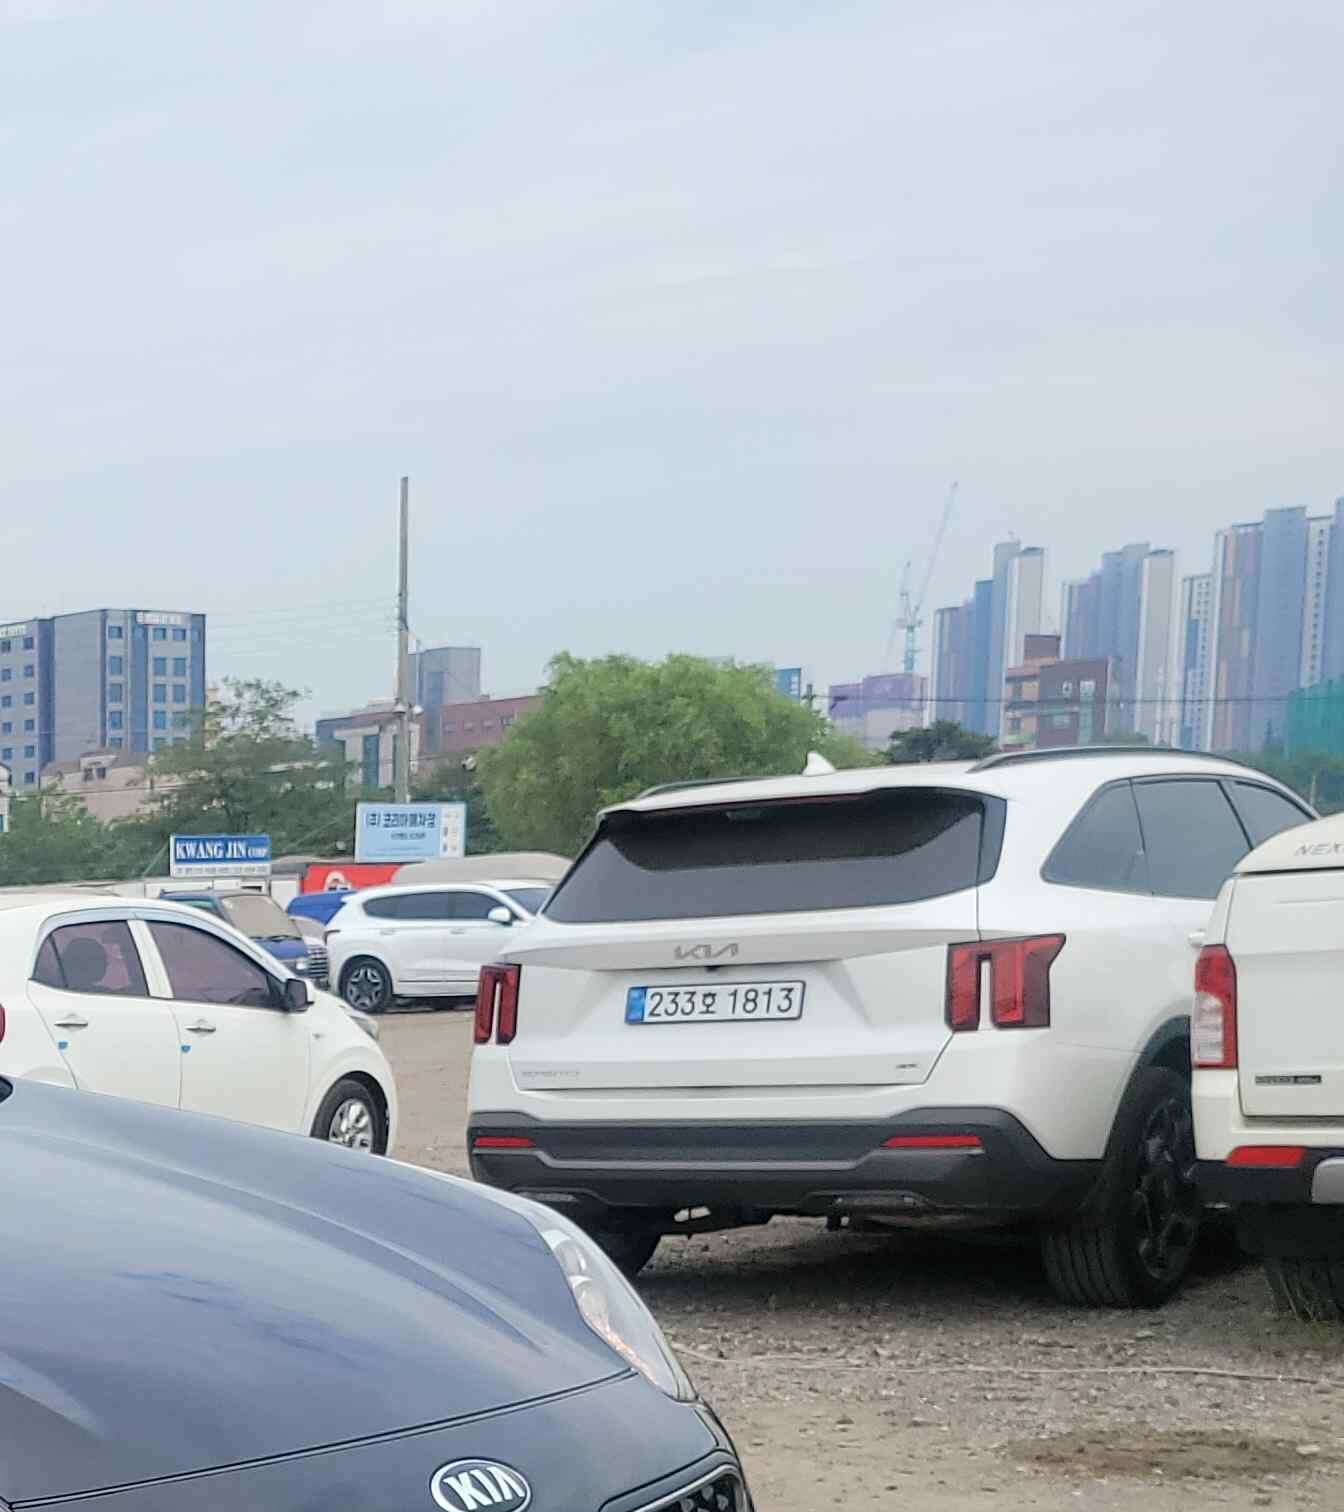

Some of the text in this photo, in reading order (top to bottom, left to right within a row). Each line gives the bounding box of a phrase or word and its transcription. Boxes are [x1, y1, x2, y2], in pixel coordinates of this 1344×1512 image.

[175, 841, 224, 859] KWANG
[225, 840, 247, 859] JIN
[648, 986, 796, 1018] 233호 1813
[442, 1466, 526, 1511] KIA
